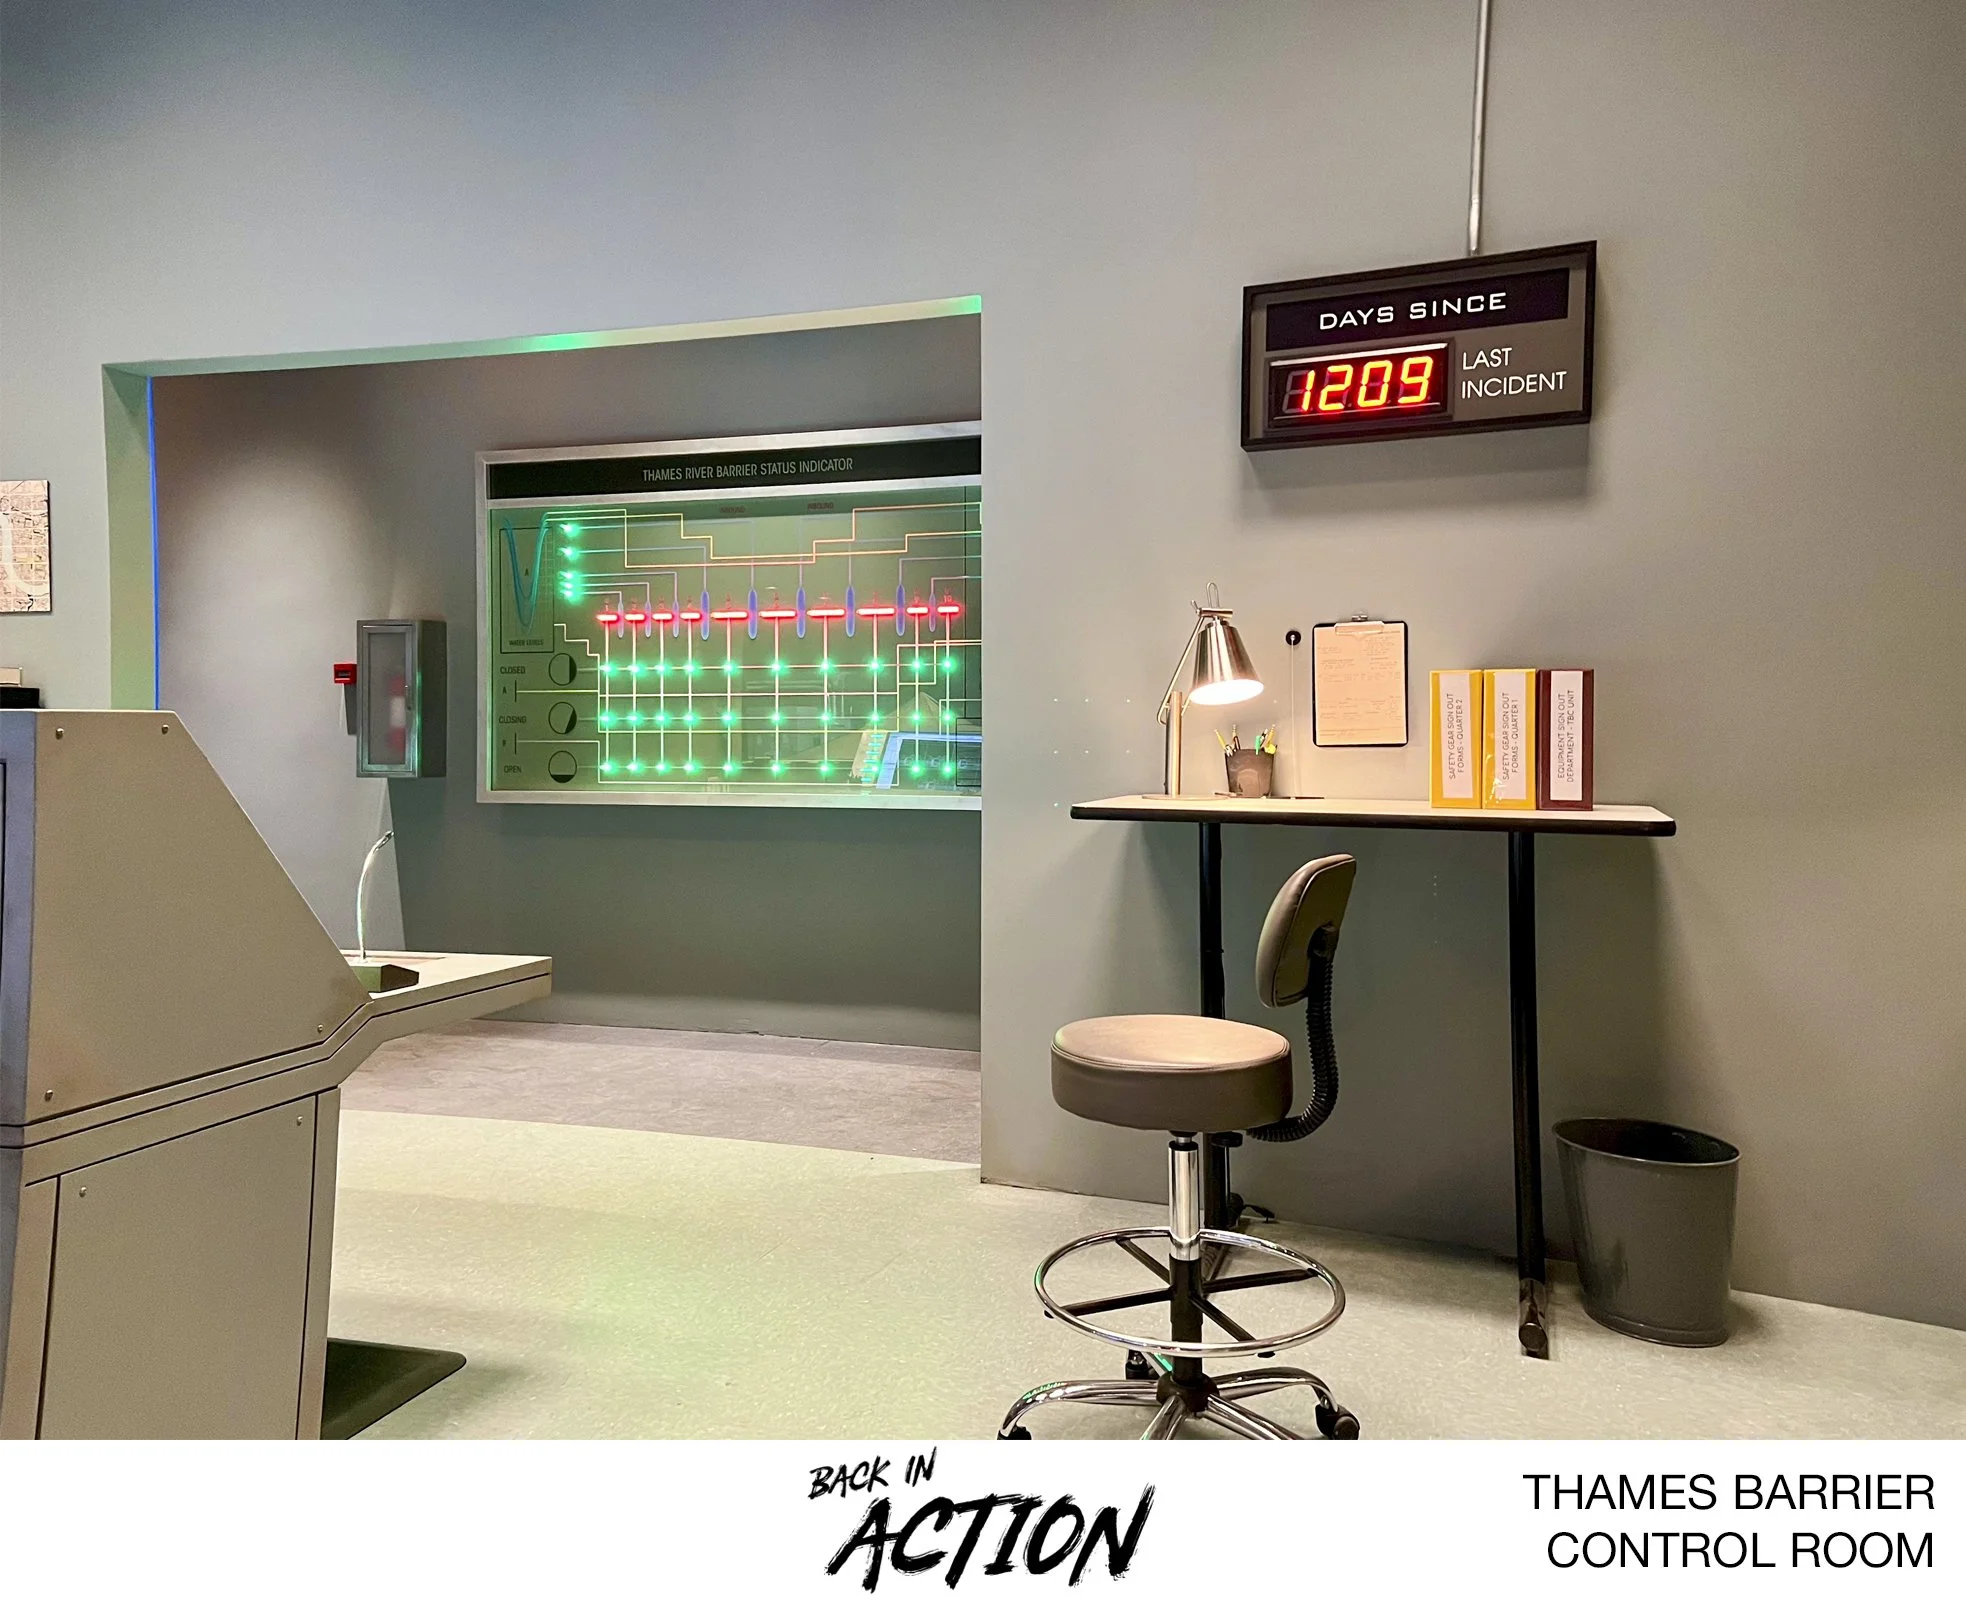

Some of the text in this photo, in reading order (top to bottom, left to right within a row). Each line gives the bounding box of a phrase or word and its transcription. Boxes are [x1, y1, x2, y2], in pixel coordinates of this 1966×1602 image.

[1319, 292, 1506, 330] DAYS SINCE
[1463, 347, 1512, 371] LAST
[1301, 355, 1434, 412] 1209
[1461, 371, 1567, 399] INCIDENT
[643, 458, 853, 481] THAMES RIVER BARRIER STATUS INDICATOR
[500, 666, 526, 674] CLOSED
[1566, 690, 1574, 708] UNIT
[499, 716, 527, 724] CLOSING
[1456, 705, 1464, 740] QUARTER
[1566, 711, 1574, 726] TBC
[1447, 731, 1455, 751] GEAR
[1557, 694, 1565, 778] EQUIPMENT SIGN OUT
[504, 765, 522, 773] OPEN
[1448, 752, 1456, 780] SAFETY
[1566, 731, 1574, 783] DEPARTMENT
